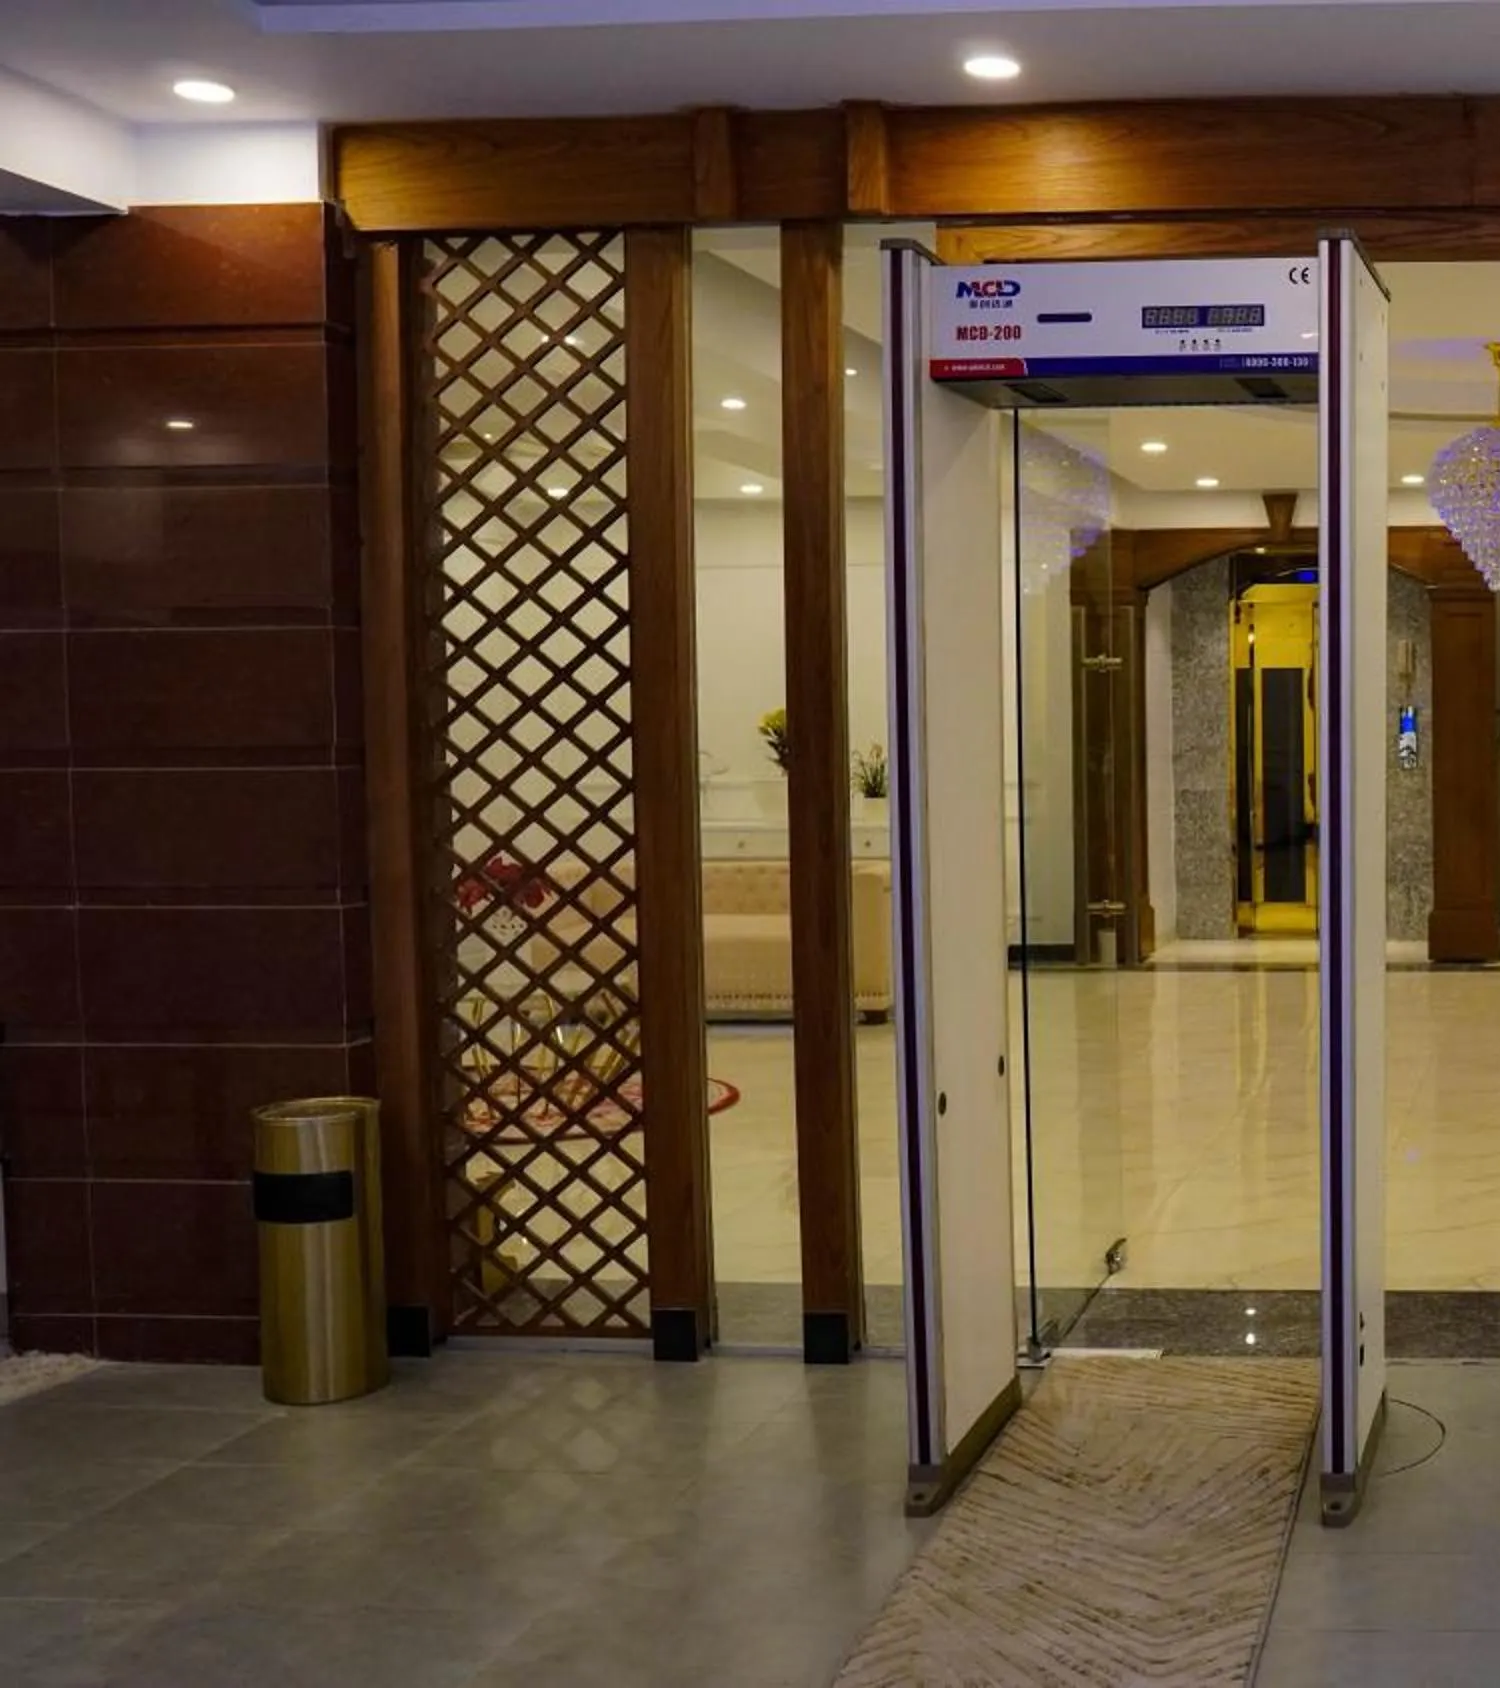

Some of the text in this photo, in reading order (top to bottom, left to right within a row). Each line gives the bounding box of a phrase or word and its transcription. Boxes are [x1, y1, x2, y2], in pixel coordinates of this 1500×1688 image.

[1289, 267, 1310, 284] CE
[956, 280, 1021, 297] MCD
[956, 325, 1021, 340] MCD-200
